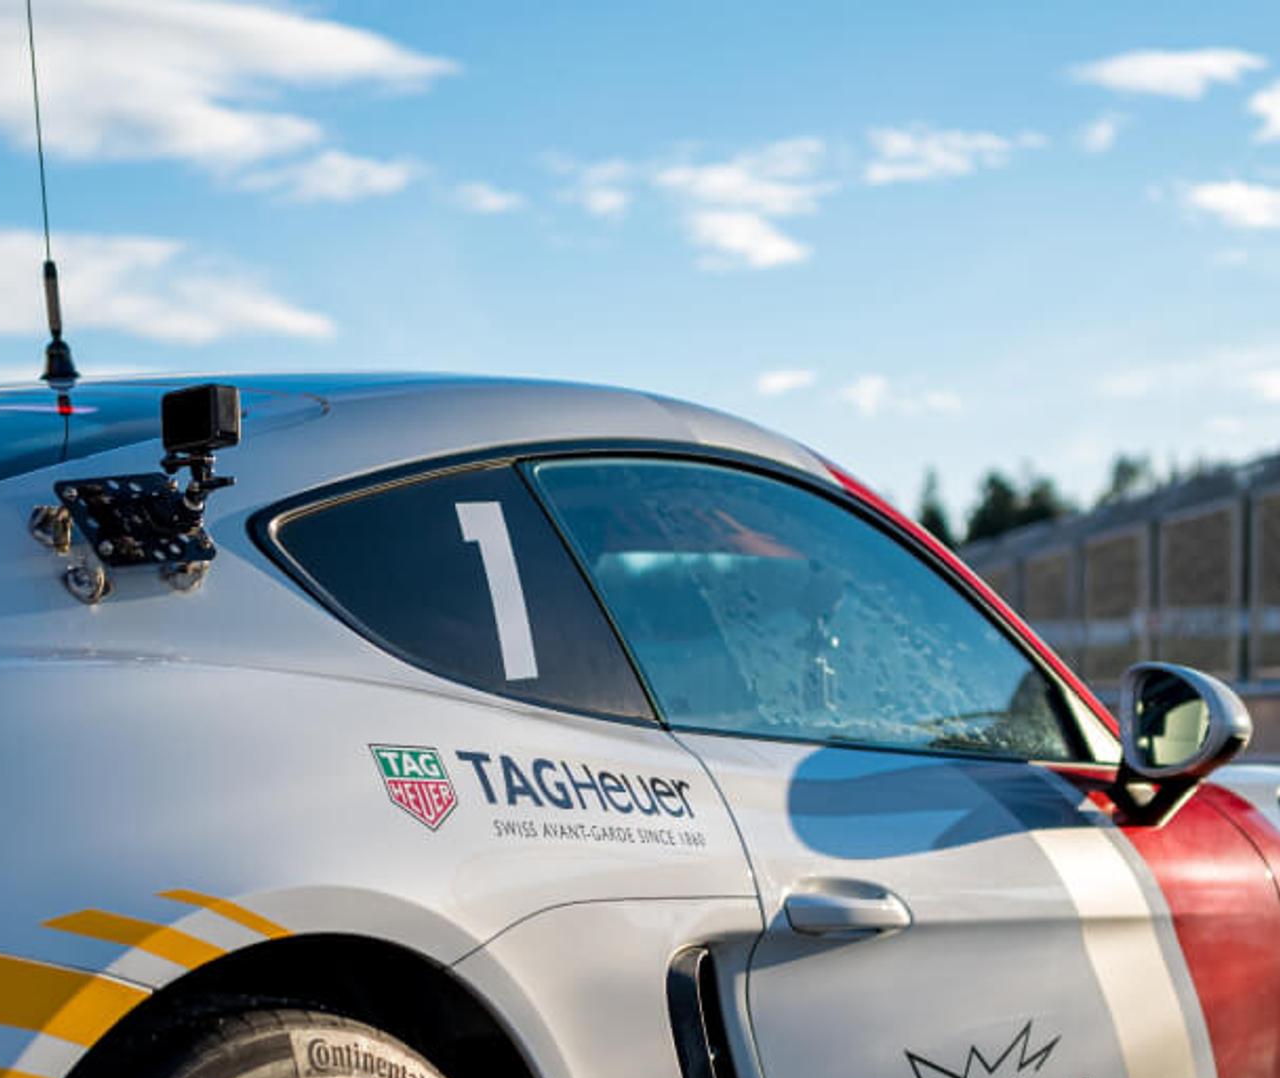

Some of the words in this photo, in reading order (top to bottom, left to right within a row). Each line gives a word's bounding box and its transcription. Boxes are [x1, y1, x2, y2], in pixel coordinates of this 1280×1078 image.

[455, 501, 538, 681] 1
[378, 752, 441, 777] TAG
[388, 782, 452, 821] HEUER
[493, 819, 538, 838] SWISS
[543, 823, 636, 845] AVANT-GARDE
[639, 828, 676, 846] SINCE
